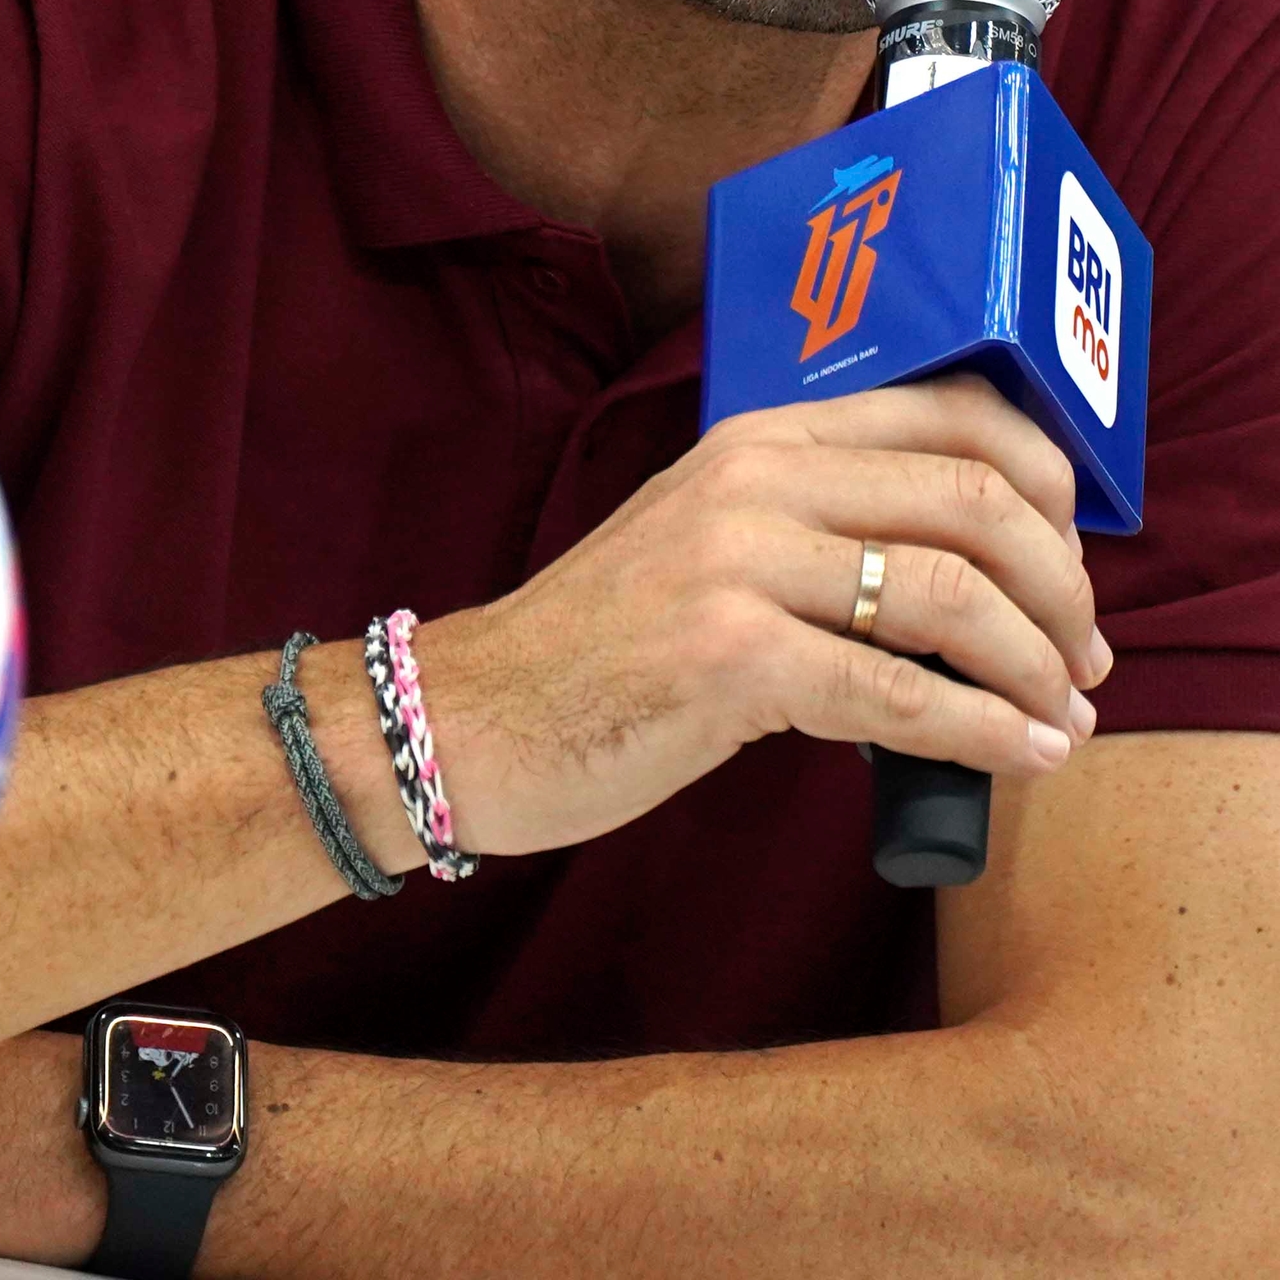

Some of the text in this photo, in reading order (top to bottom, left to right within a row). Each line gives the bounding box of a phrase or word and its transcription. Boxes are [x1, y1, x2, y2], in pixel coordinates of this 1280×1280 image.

[991, 26, 1024, 48] SM58
[1067, 215, 1111, 336] BRI
[802, 345, 879, 385] LIGA INDONESIA BARU
[1073, 305, 1110, 381] mo
